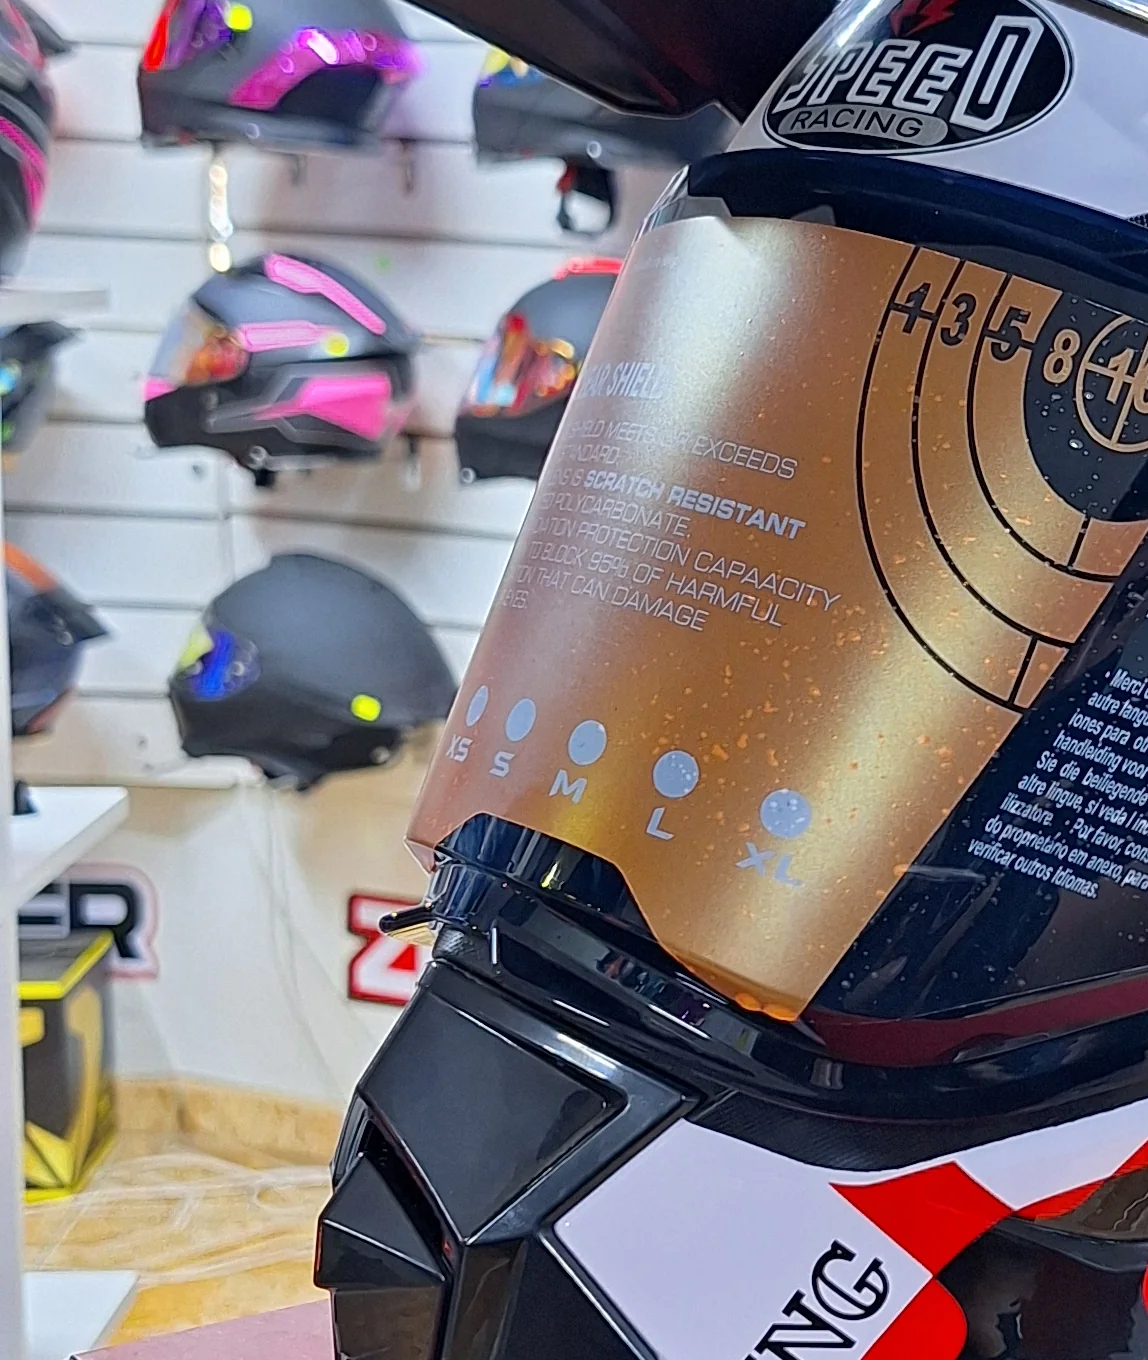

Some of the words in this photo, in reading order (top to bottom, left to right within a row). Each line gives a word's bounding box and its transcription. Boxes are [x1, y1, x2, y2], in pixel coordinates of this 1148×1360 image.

[771, 15, 1044, 132] SPEED
[790, 110, 925, 138] RACING
[940, 292, 977, 346] 3
[990, 306, 1031, 360] 5
[1043, 329, 1081, 384] 8
[691, 436, 798, 479] EXCEEDS
[584, 470, 666, 500] SCRATCH
[666, 486, 807, 540] RESISTANT
[576, 521, 691, 567] PROTECTION
[694, 551, 842, 612] CAPAACITY
[571, 576, 610, 601] CAN
[611, 586, 710, 632] DAMAGE
[588, 552, 630, 579] 95%
[633, 563, 664, 585] OF
[665, 572, 782, 627] HARMFUL
[1088, 691, 1121, 715] autre
[1110, 668, 1148, 697] Merci
[446, 734, 474, 763] XS
[1052, 730, 1121, 773] handleiding
[1099, 725, 1131, 747] para
[489, 751, 515, 778] S
[1036, 750, 1058, 773] Sie
[1059, 760, 1081, 780] die
[549, 770, 588, 804] M
[1018, 773, 1047, 795] altre
[1045, 780, 1084, 814] lingue,
[1101, 803, 1128, 826] veda
[646, 807, 675, 840] L
[1071, 817, 1095, 840] Por
[735, 842, 804, 888] XL
[967, 838, 1017, 868] verificar
[1014, 857, 1054, 881] outros
[985, 815, 1000, 834] do
[1067, 847, 1085, 865] em
[1086, 855, 1123, 883] anexo,
